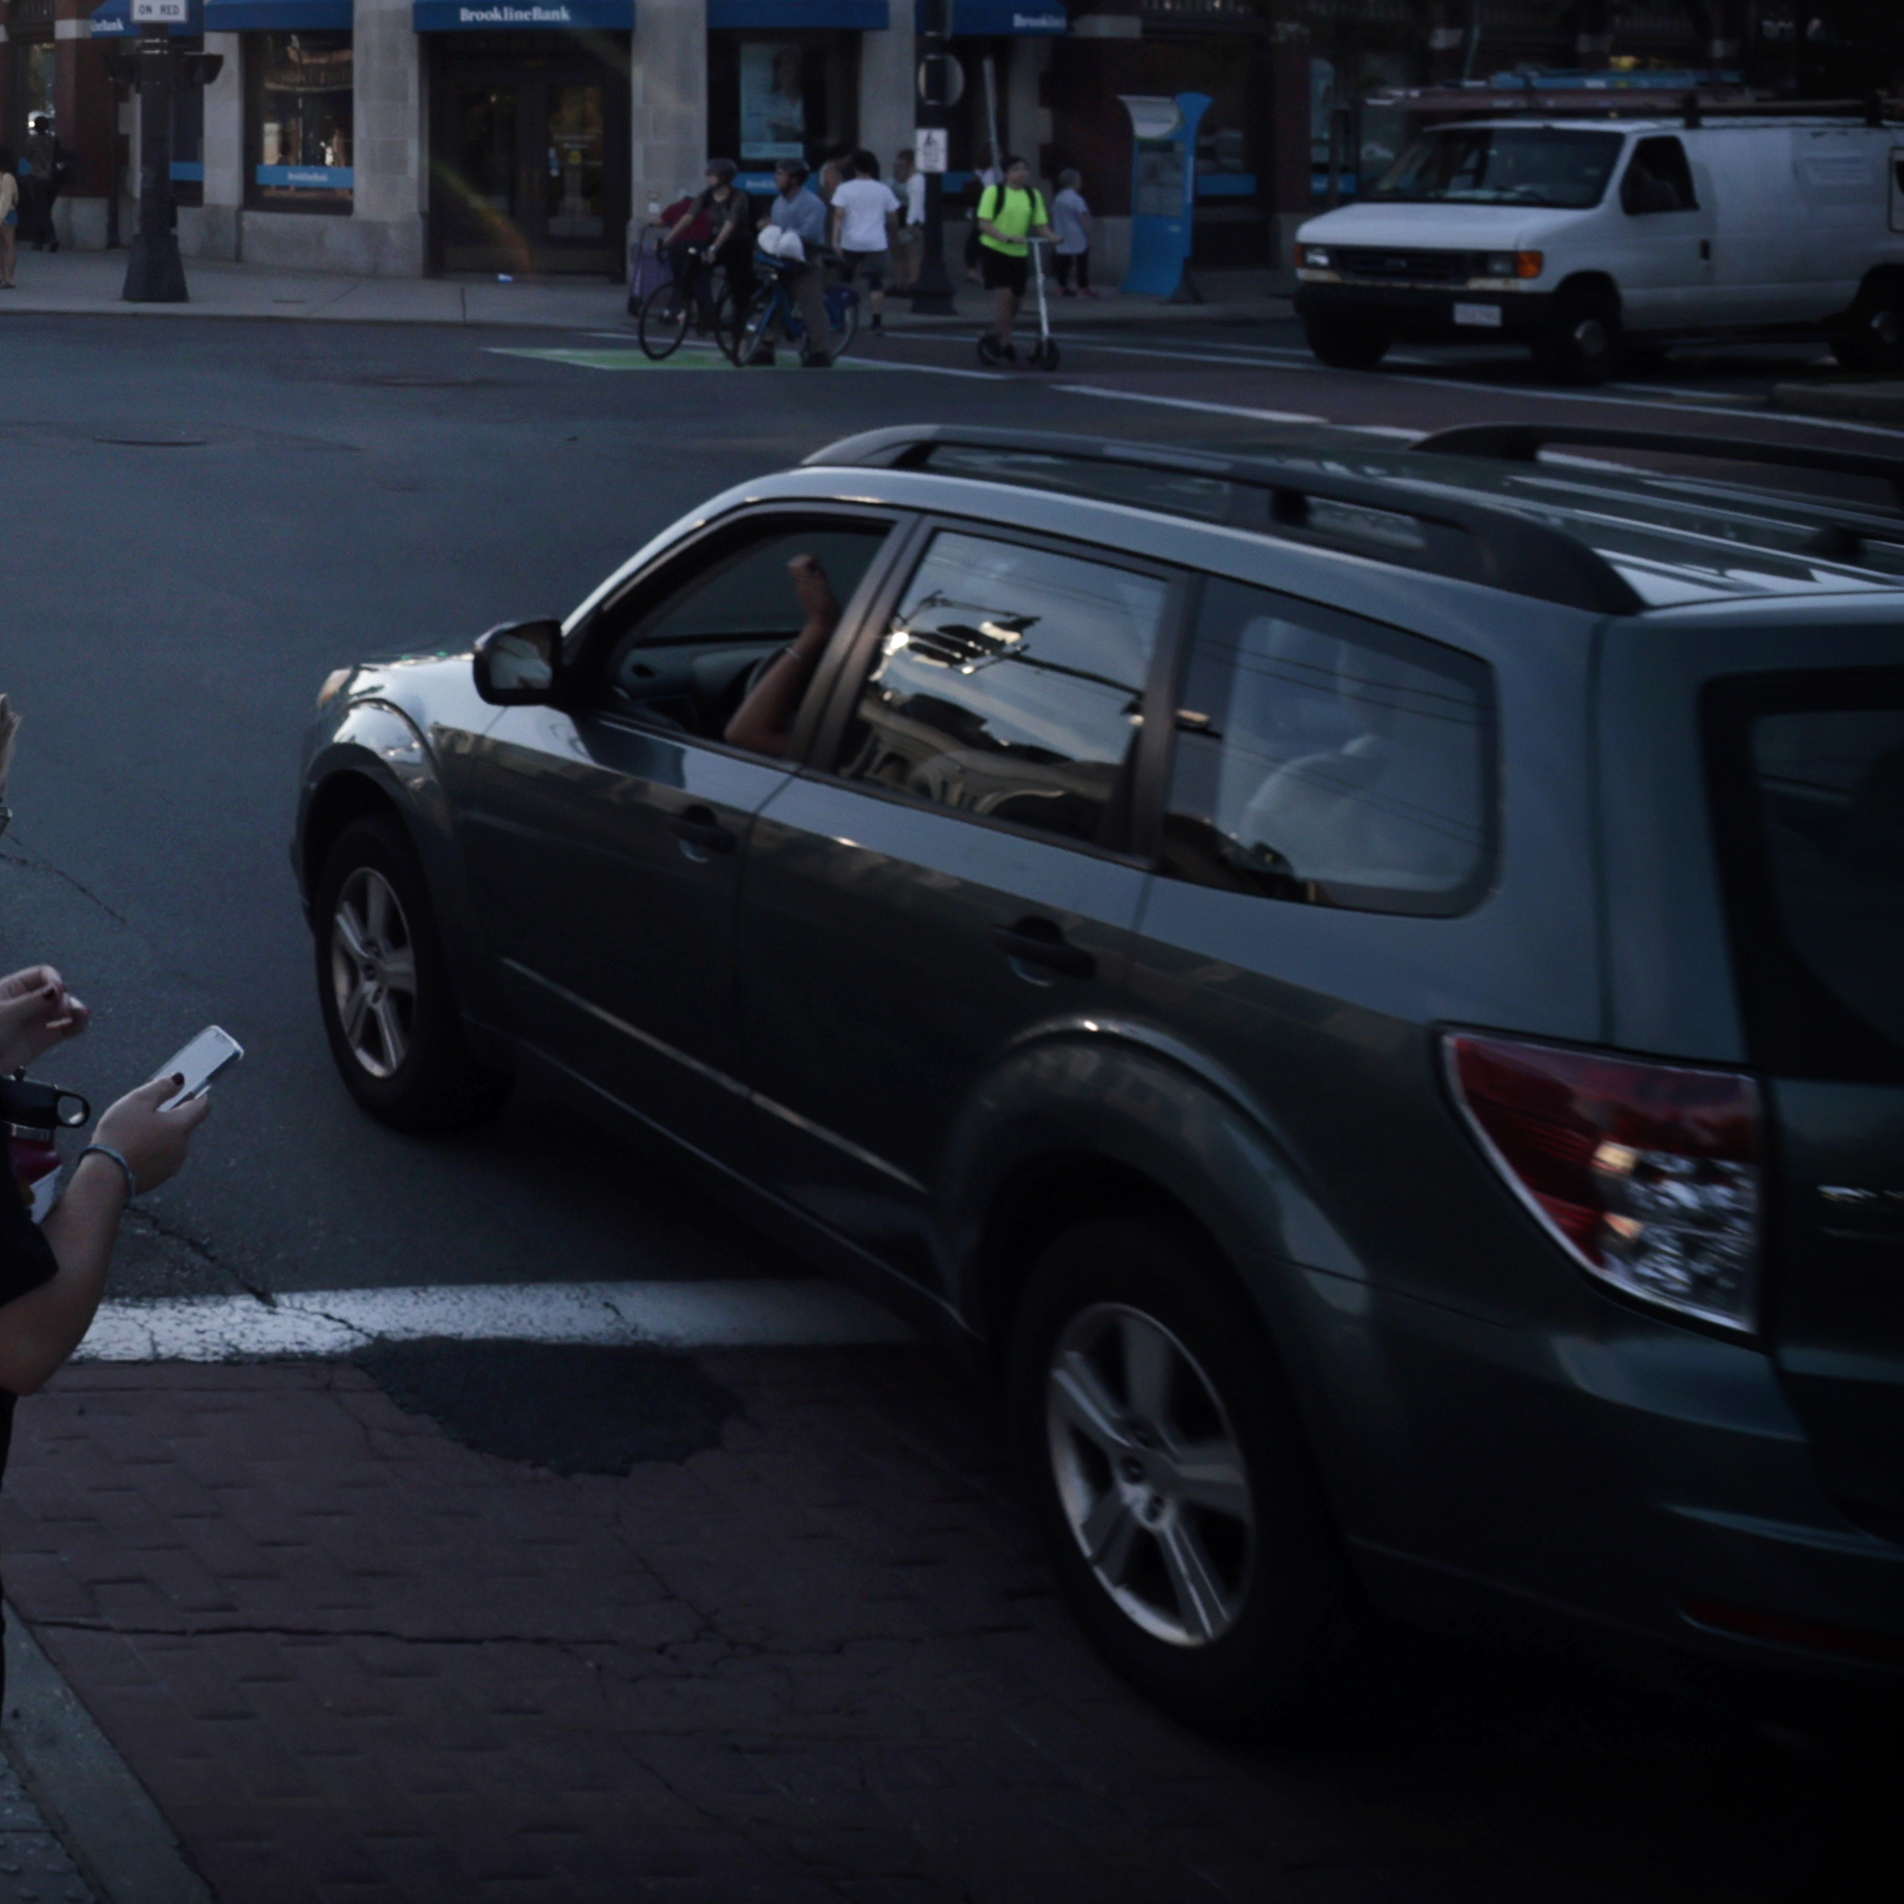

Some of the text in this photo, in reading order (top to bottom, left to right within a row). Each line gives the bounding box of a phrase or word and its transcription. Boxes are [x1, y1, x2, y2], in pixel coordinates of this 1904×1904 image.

[139, 5, 179, 16] ON RED
[459, 5, 571, 22] BrooklineBank
